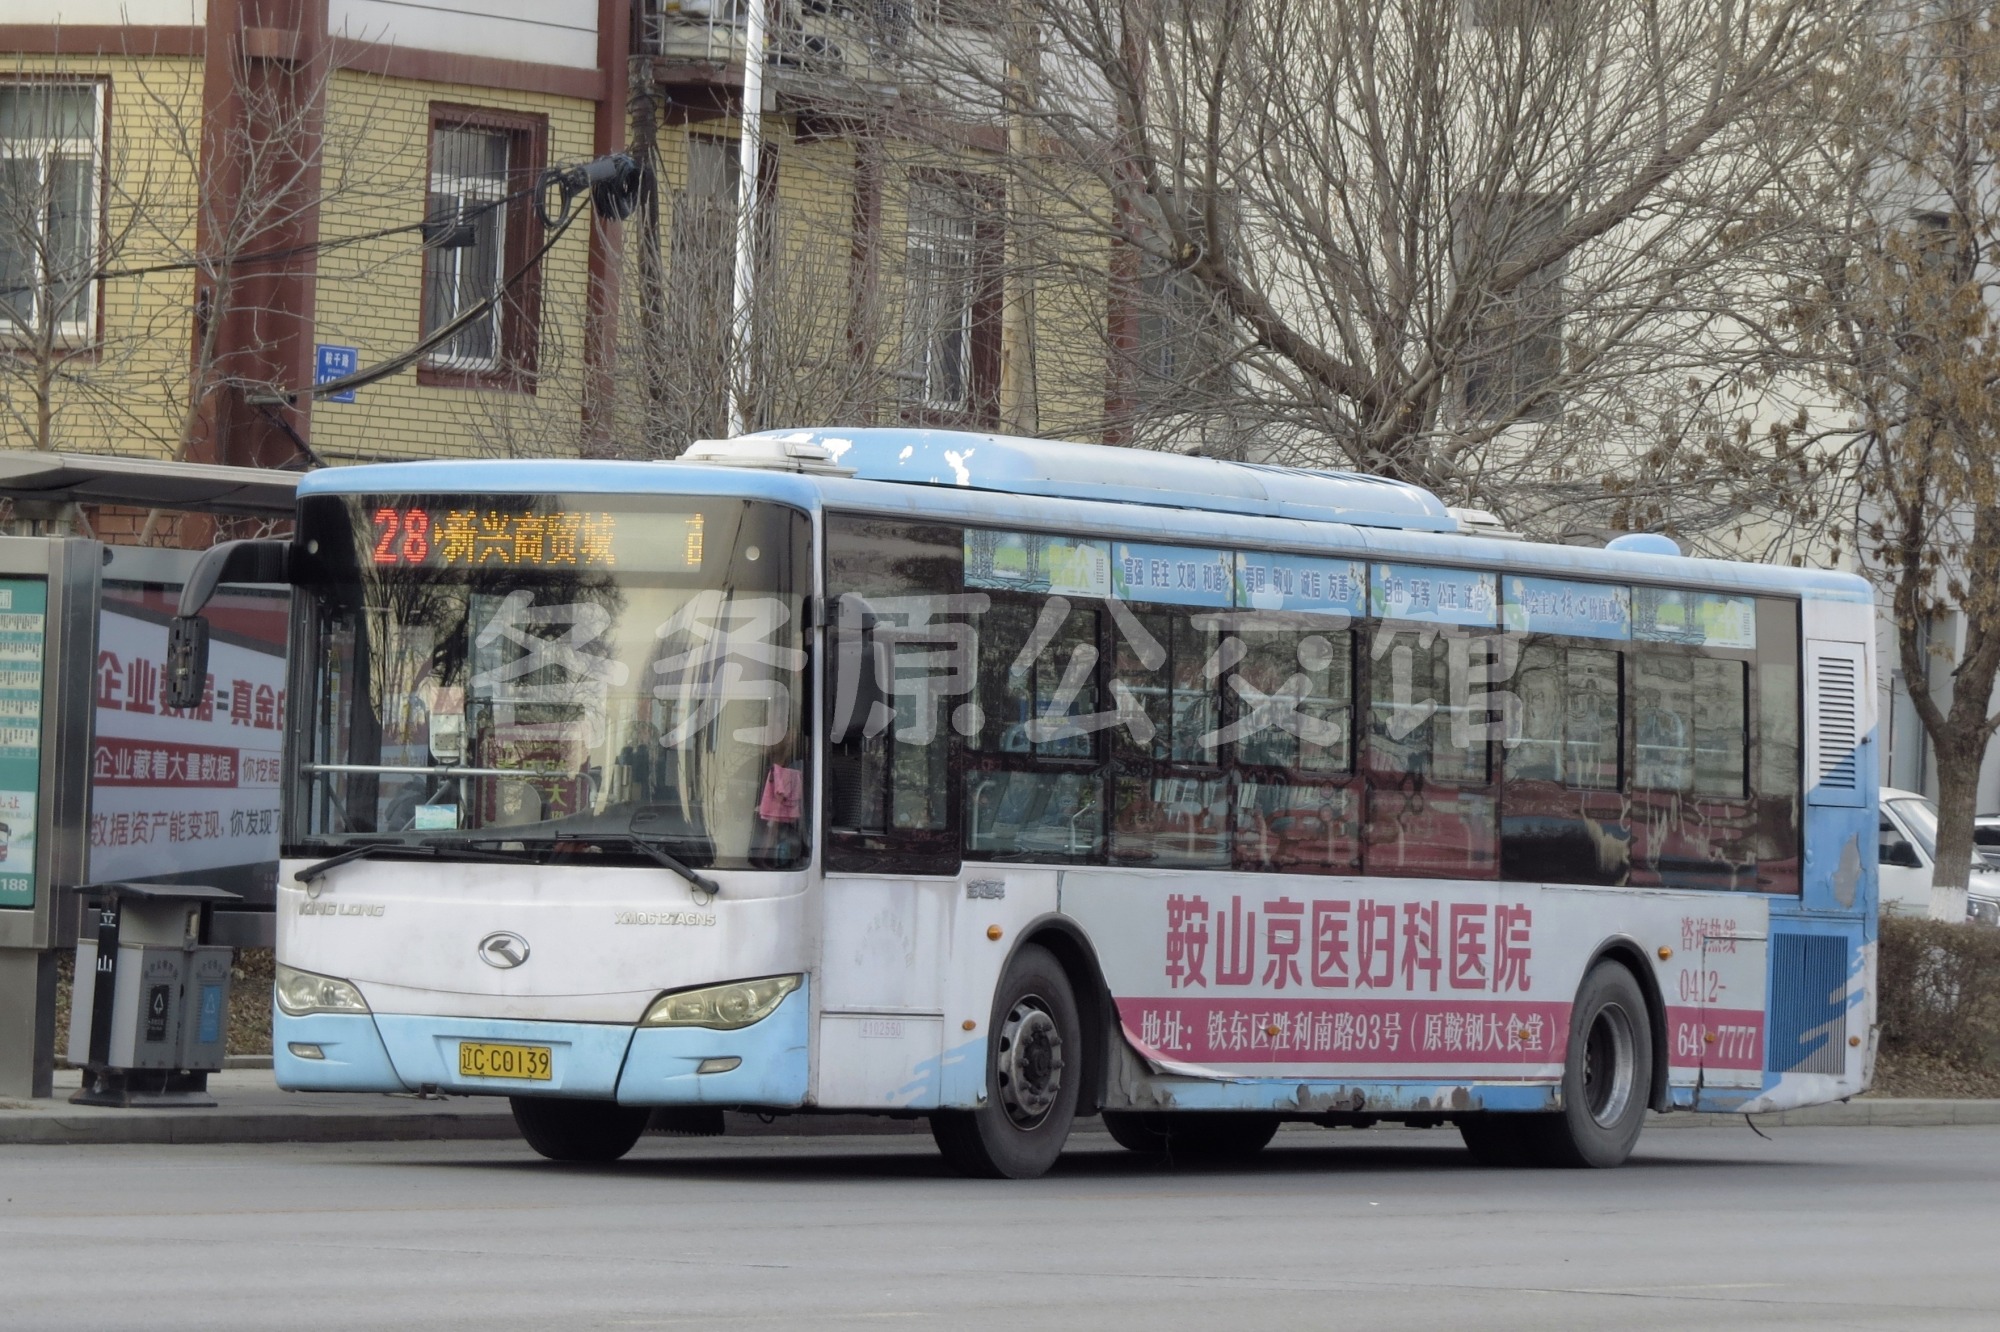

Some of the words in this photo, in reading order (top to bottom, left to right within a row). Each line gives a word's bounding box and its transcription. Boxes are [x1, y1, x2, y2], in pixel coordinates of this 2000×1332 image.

[374, 508, 429, 562] 28
[443, 510, 616, 565] 新兴商贸城
[1124, 558, 1144, 587] 富强
[1150, 560, 1170, 588] 民主
[1176, 562, 1196, 590] 文明
[1203, 564, 1223, 592] 和谐
[1245, 566, 1266, 593] 爱国
[1273, 568, 1293, 596] 敬业
[1301, 570, 1321, 598] 诚信
[1328, 572, 1348, 601] 友善
[1384, 578, 1403, 604] 自由
[1410, 580, 1430, 607] 平等
[1437, 582, 1457, 610] 公正
[1463, 584, 1483, 612] 法治
[299, 902, 337, 915] KING
[339, 903, 385, 917] LONG
[615, 912, 716, 926] XMQ6127AGN5
[1164, 893, 1532, 993] 鞍山京医妇科医院
